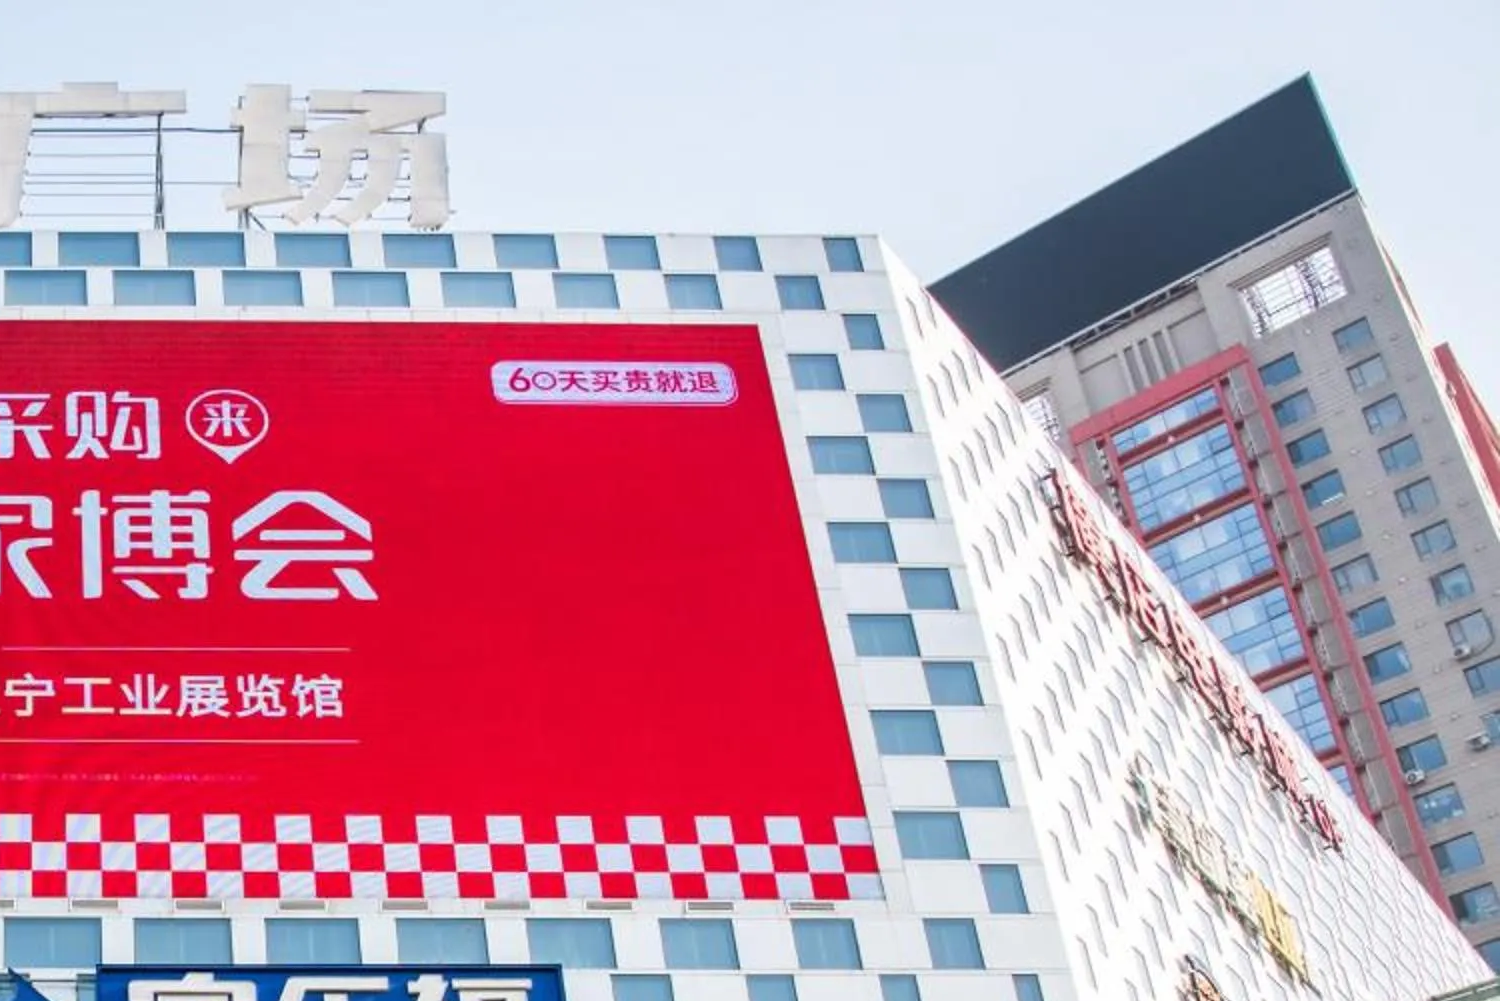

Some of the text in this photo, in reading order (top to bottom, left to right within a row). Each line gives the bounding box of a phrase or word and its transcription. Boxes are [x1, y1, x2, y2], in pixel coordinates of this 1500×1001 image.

[508, 366, 721, 394] 60天买贵就退
[202, 401, 253, 438] 来
